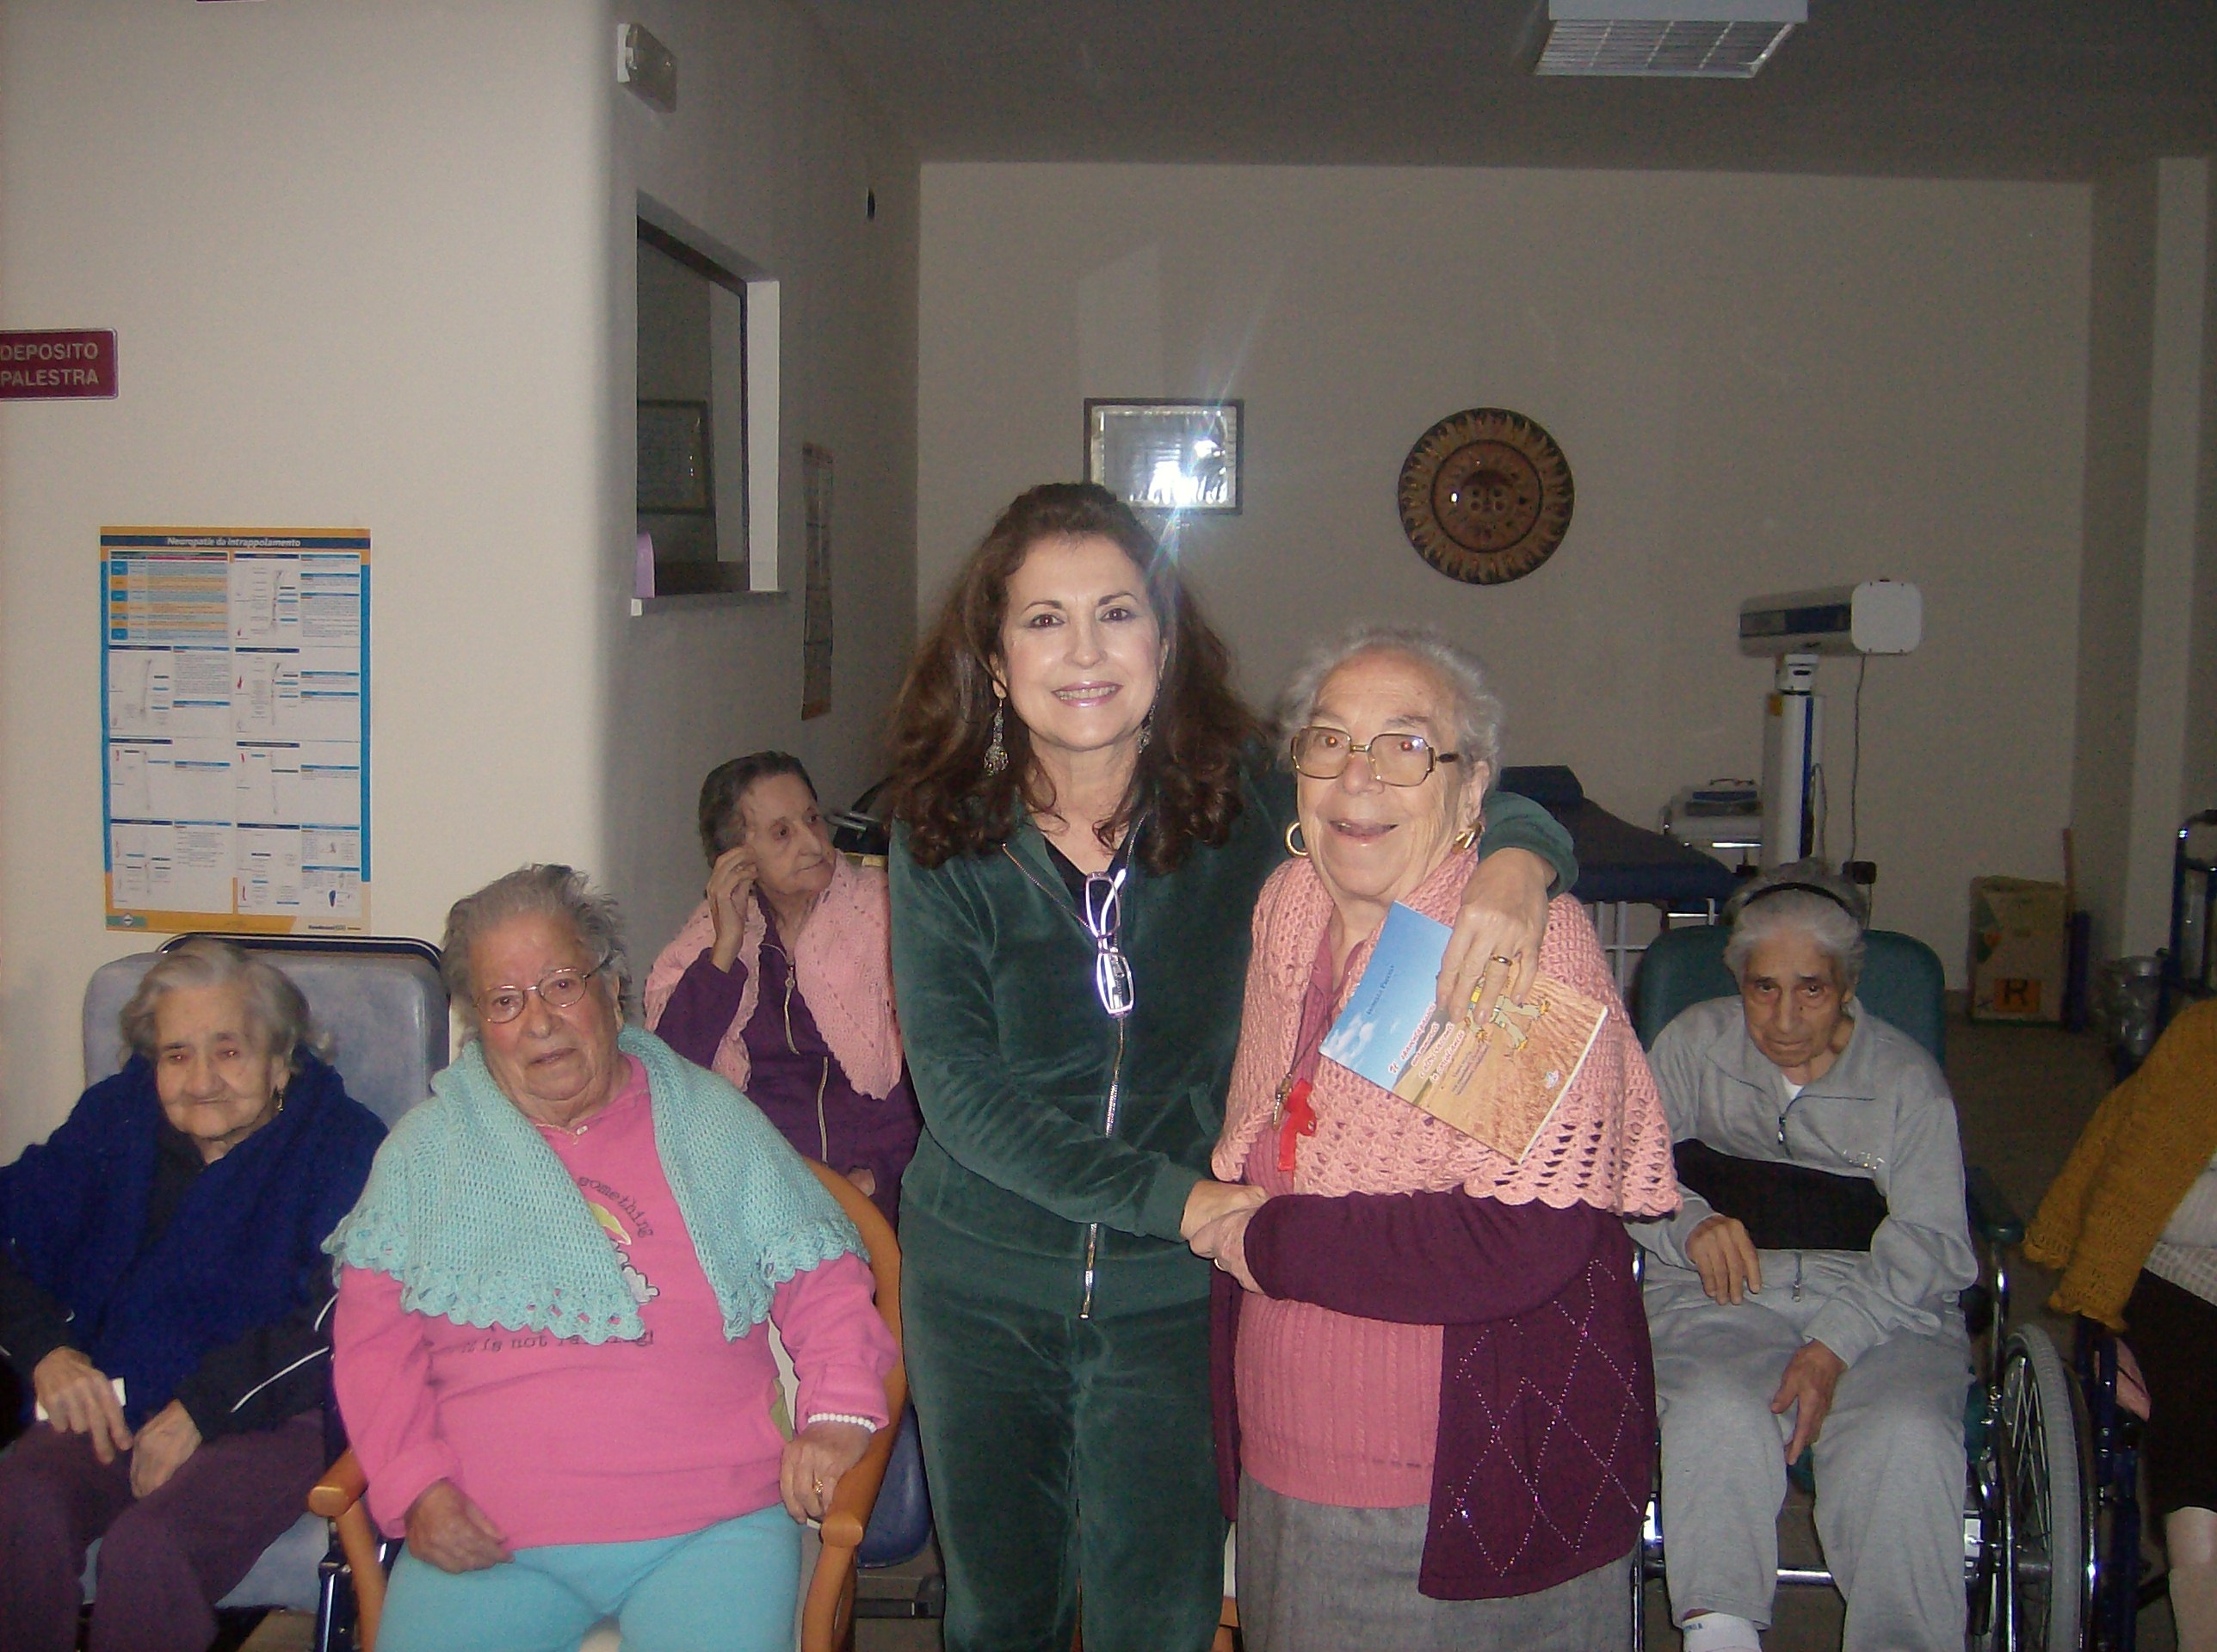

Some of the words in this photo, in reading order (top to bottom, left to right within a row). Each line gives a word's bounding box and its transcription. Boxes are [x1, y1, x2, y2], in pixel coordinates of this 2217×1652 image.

[0, 342, 99, 361] DEPOSITO
[0, 368, 100, 386] PALESTRA
[167, 536, 215, 548] Neuropatie
[216, 537, 227, 546] da
[227, 537, 301, 548] intrappolamento
[577, 1176, 653, 1238] something
[511, 1335, 547, 1348] not
